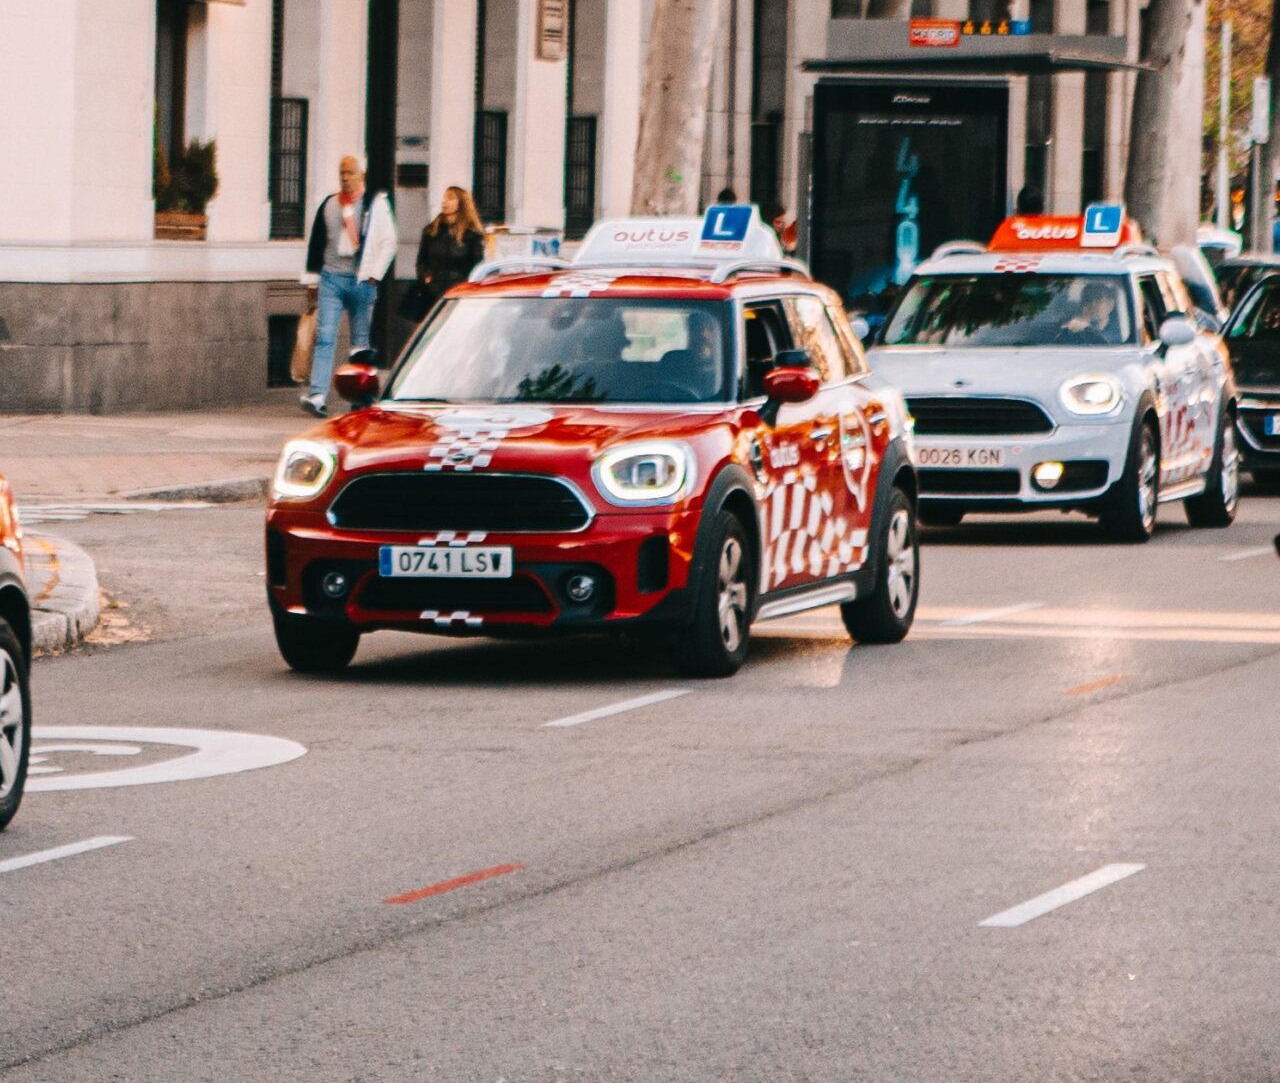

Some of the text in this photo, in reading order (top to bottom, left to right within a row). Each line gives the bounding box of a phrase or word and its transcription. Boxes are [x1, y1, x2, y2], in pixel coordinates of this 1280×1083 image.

[713, 212, 733, 235] L
[1093, 212, 1109, 230] L
[919, 448, 1000, 465] 0026 KGN
[399, 552, 451, 572] 0741
